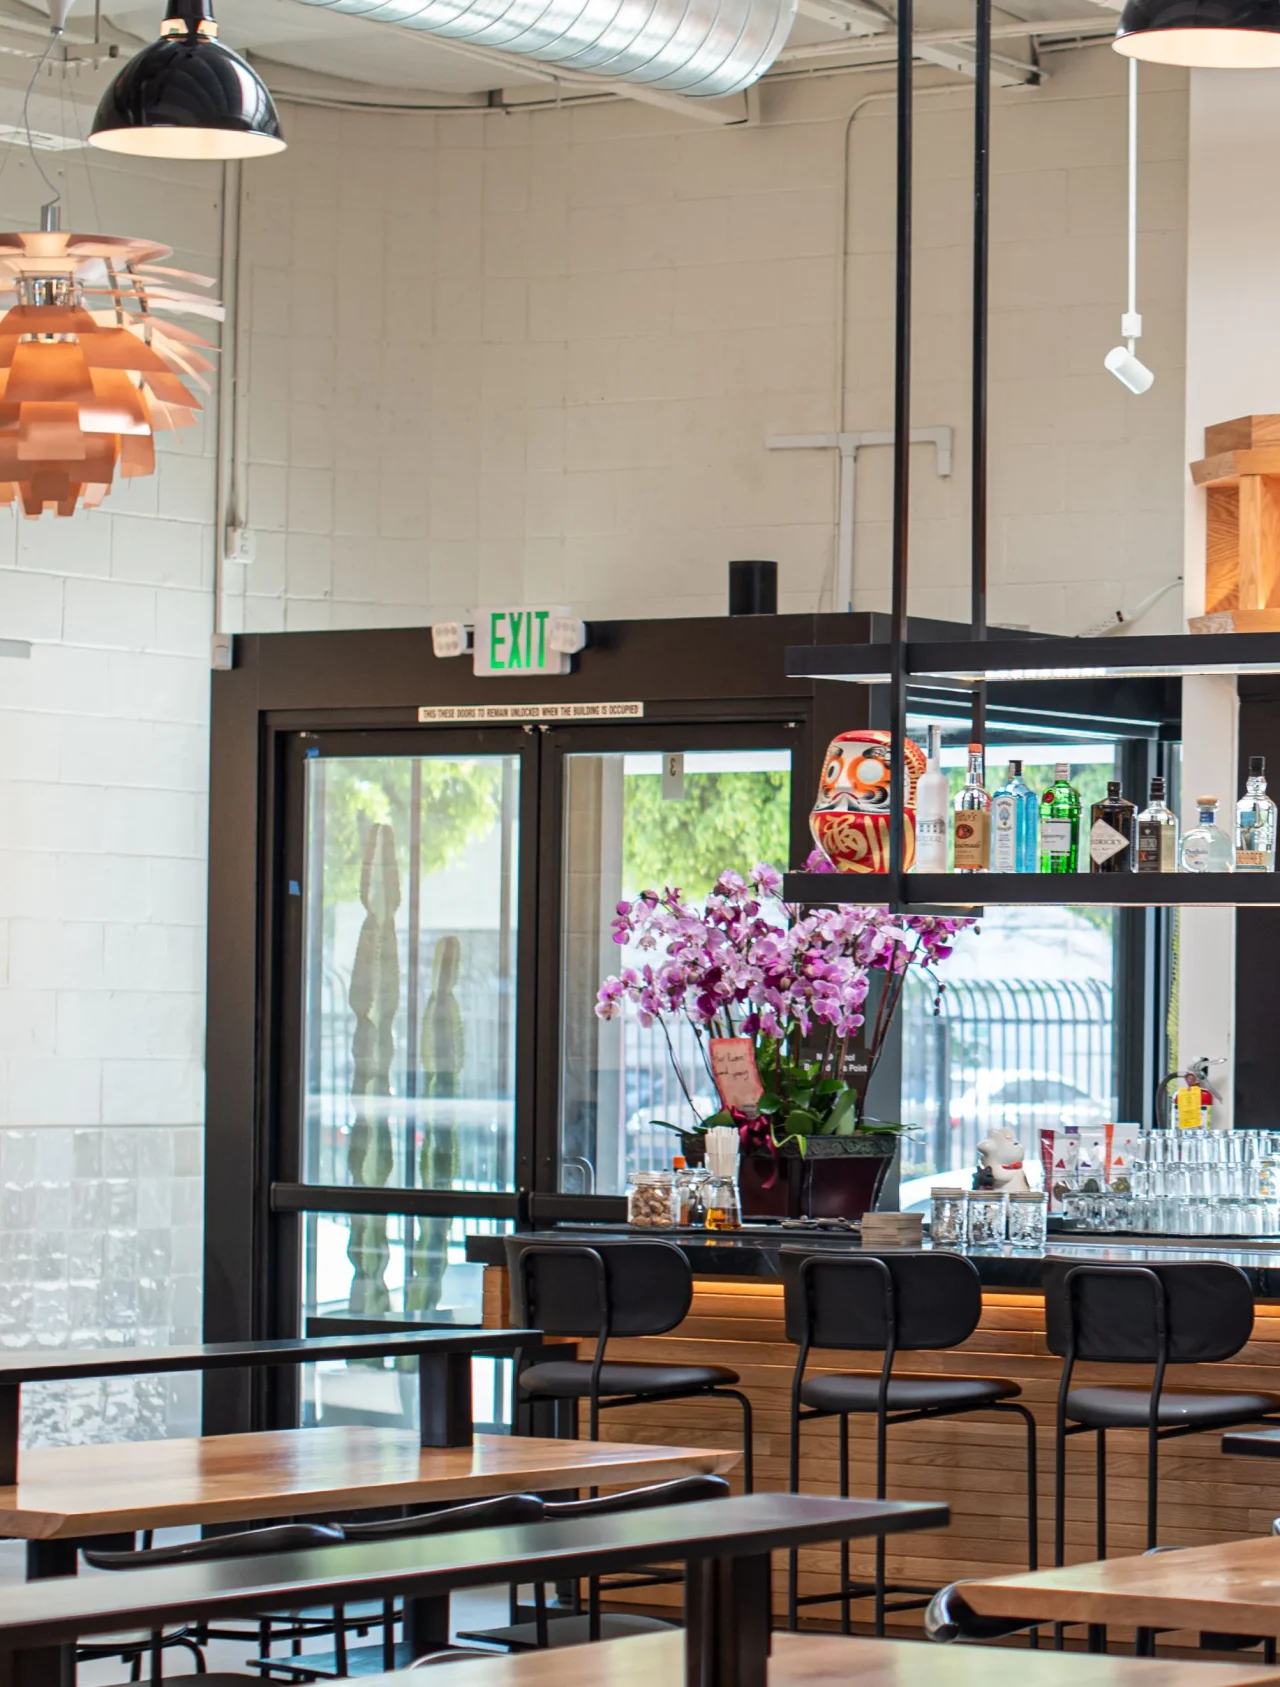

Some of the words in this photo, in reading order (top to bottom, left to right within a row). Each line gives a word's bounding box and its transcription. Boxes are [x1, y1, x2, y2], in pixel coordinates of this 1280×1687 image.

[490, 611, 549, 669] EXIT
[438, 708, 455, 718] THESE
[457, 708, 476, 718] DOORS
[478, 708, 485, 717] TO
[487, 708, 508, 717] REMAIN
[510, 707, 540, 717] UNLOCKED
[542, 707, 558, 716] WHEN
[561, 707, 571, 716] THE
[573, 706, 600, 715] BUILDING
[602, 706, 608, 714] IS
[609, 705, 638, 714] OCCUPIED
[849, 1064, 868, 1072] Point
